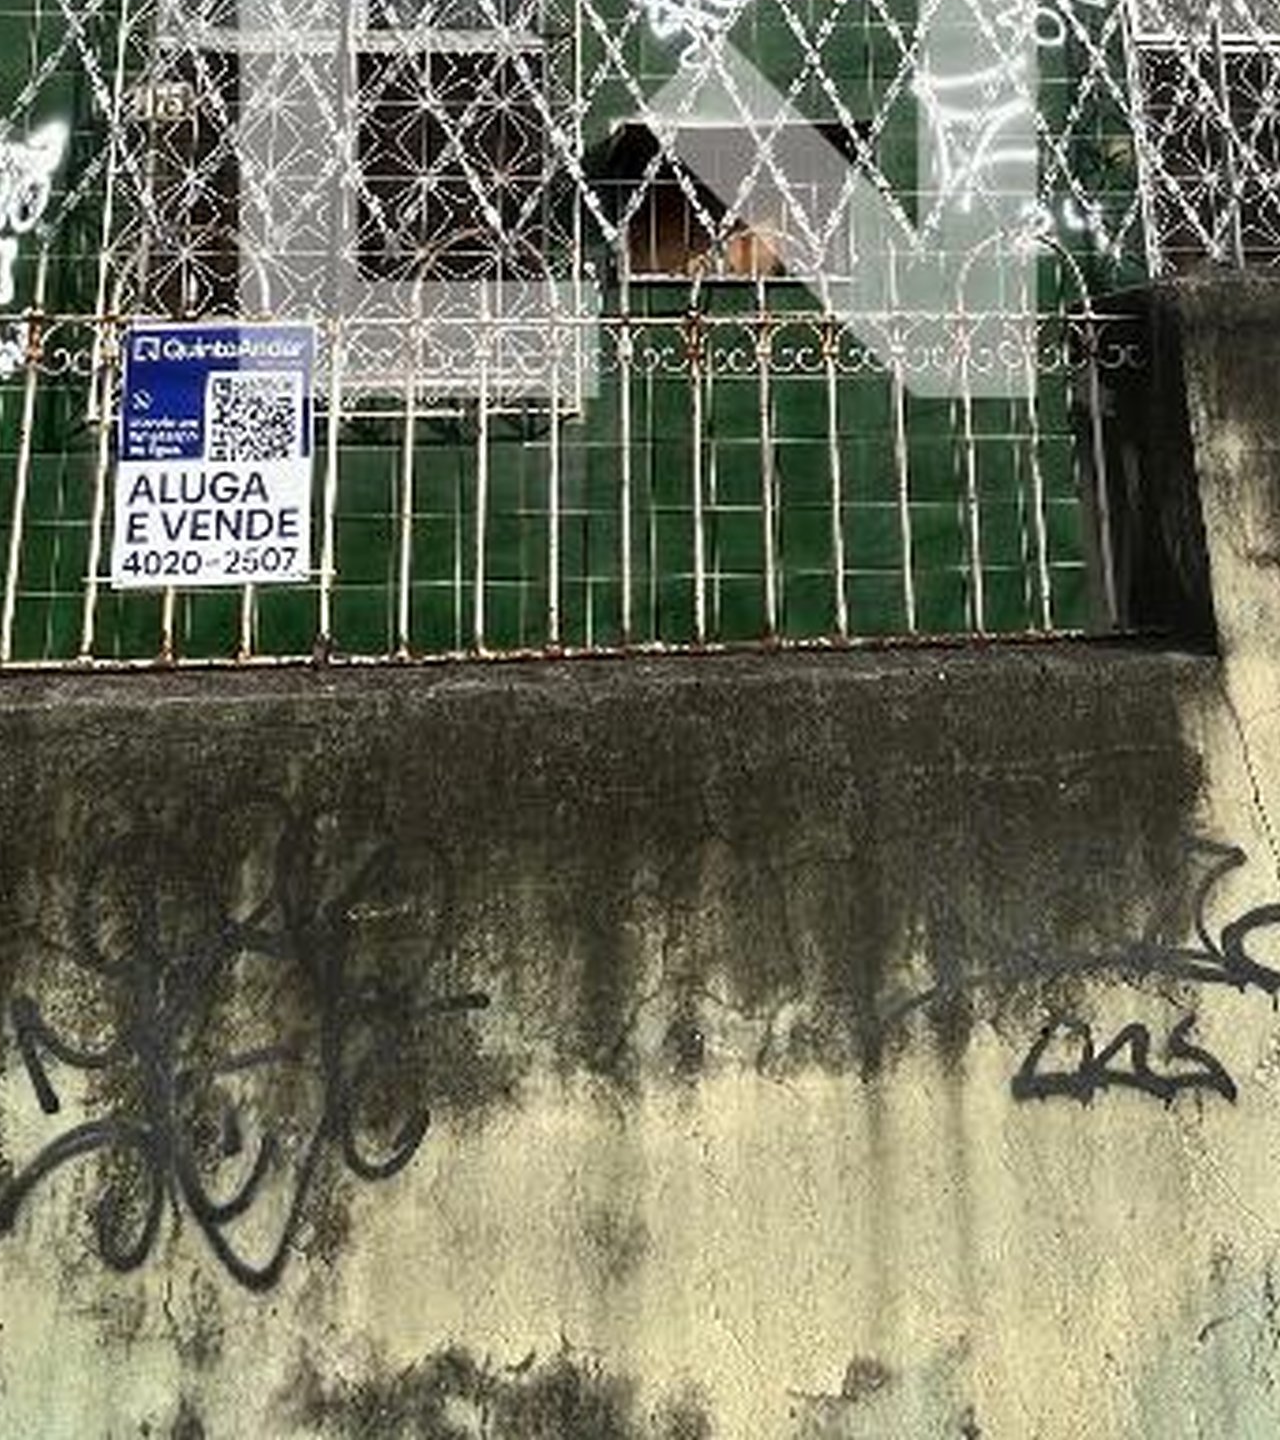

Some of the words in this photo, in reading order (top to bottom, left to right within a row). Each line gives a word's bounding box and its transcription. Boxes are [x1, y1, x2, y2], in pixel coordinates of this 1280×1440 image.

[128, 471, 270, 505] ALUGA
[125, 512, 150, 544] E
[160, 507, 300, 542] VENDE
[122, 546, 299, 576] 4020-2507
